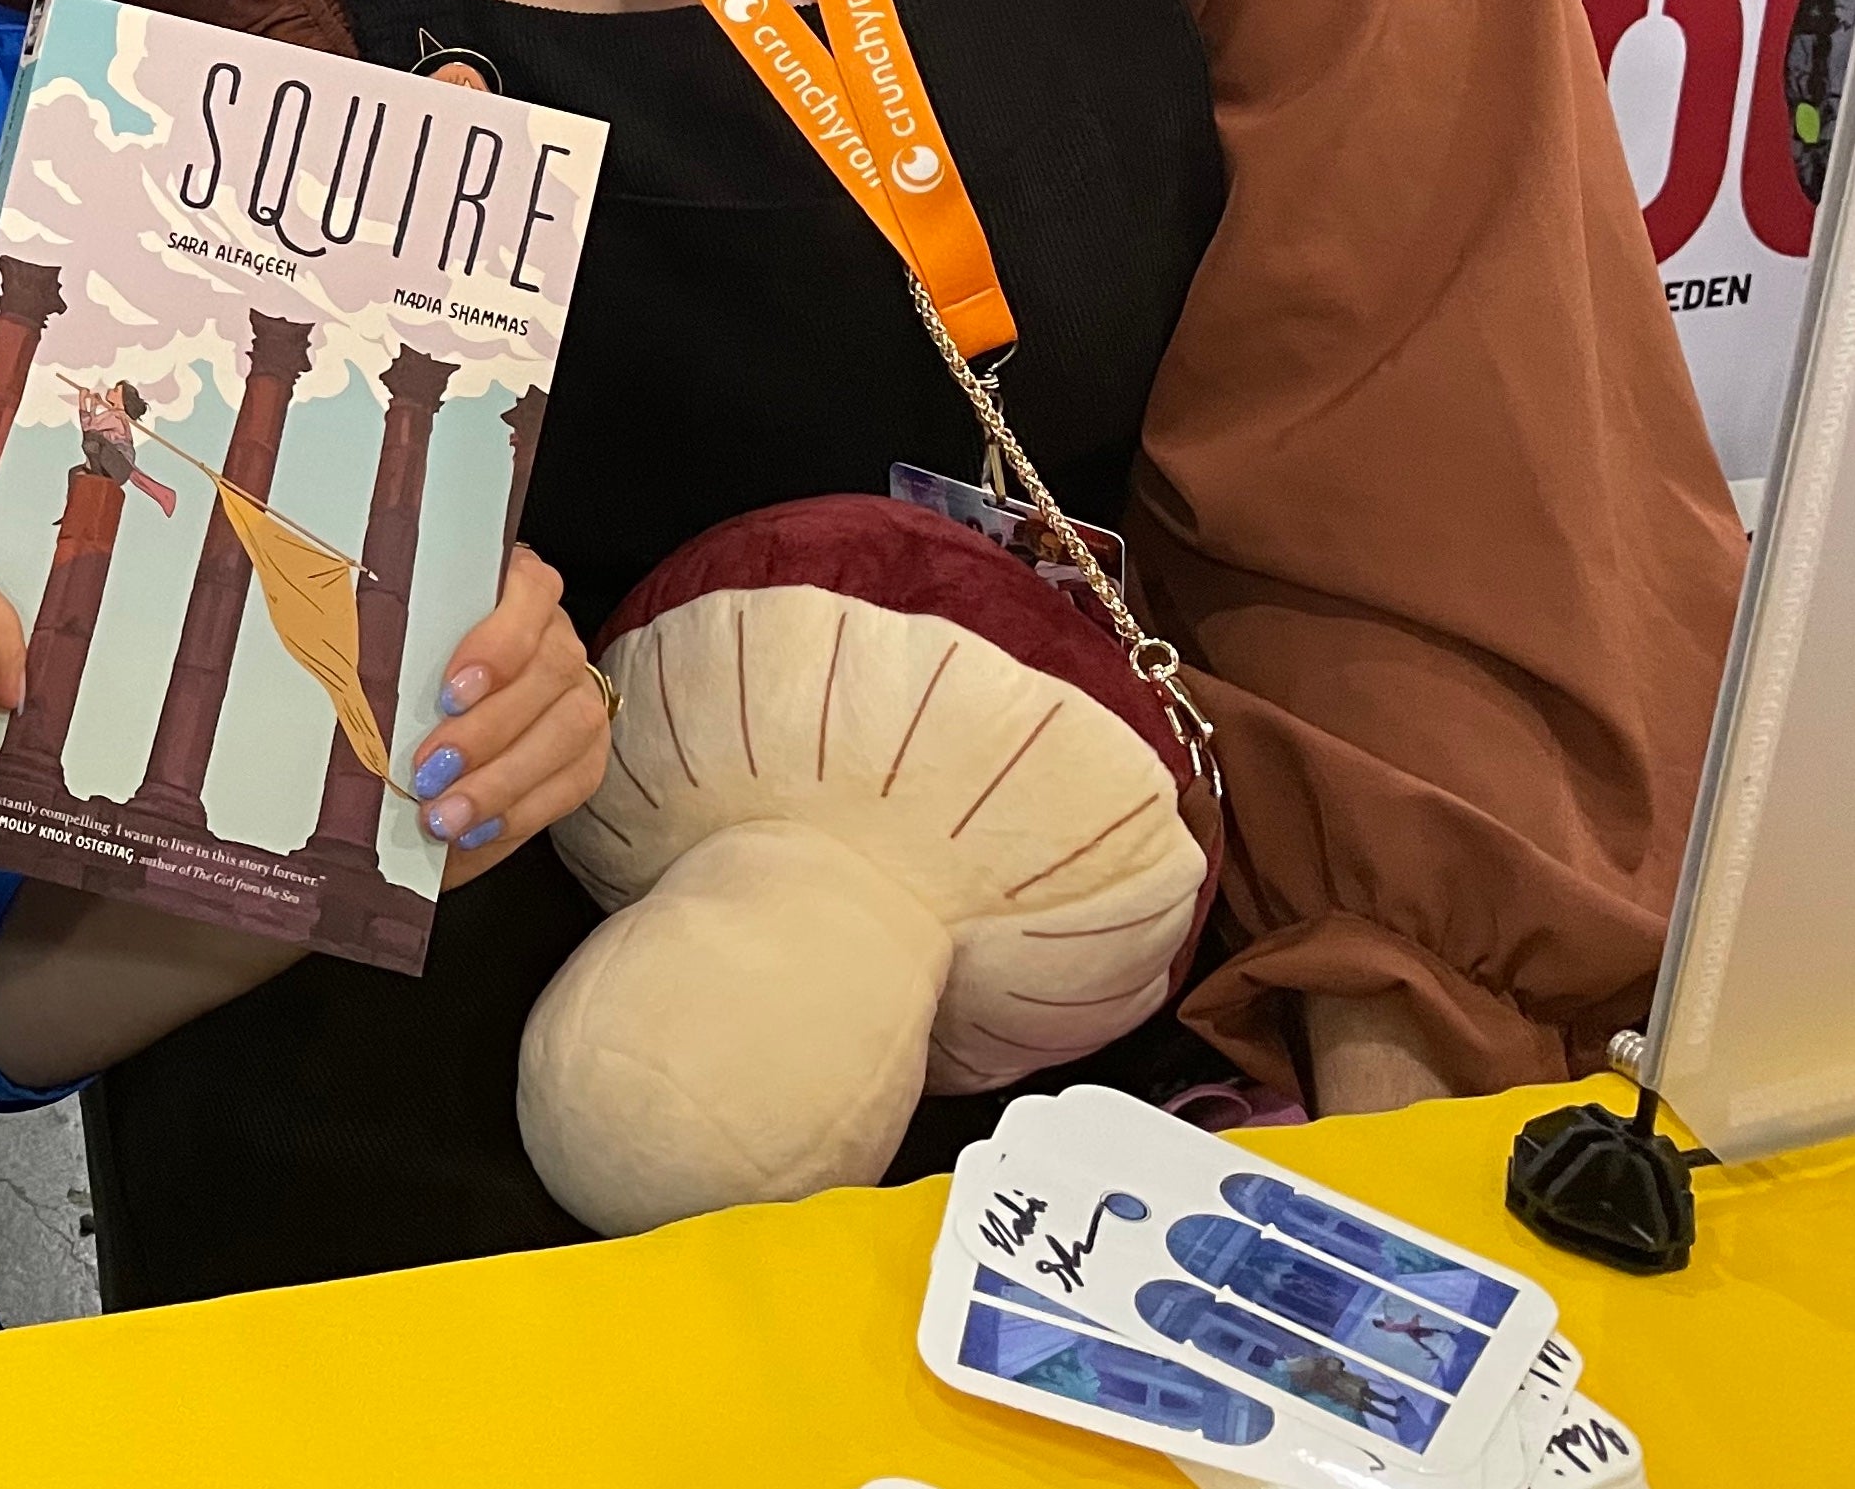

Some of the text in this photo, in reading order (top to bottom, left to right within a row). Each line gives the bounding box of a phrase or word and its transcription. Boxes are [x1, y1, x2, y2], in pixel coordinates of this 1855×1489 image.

[179, 62, 571, 293] SQUIRE
[167, 232, 297, 282] SARA ALFAGEEH
[393, 288, 529, 336] NADIA SHAMMAS
[39, 825, 73, 845] KNOX
[139, 855, 177, 873] author
[178, 864, 192, 876] of
[194, 866, 212, 881] The
[213, 872, 235, 888] Girl
[233, 878, 261, 894] from
[262, 886, 280, 900] the
[115, 823, 122, 836] I
[124, 829, 154, 844] want
[156, 835, 169, 848] to
[171, 838, 194, 854] live
[196, 845, 209, 859] in
[212, 849, 236, 866] this
[238, 858, 271, 877] story
